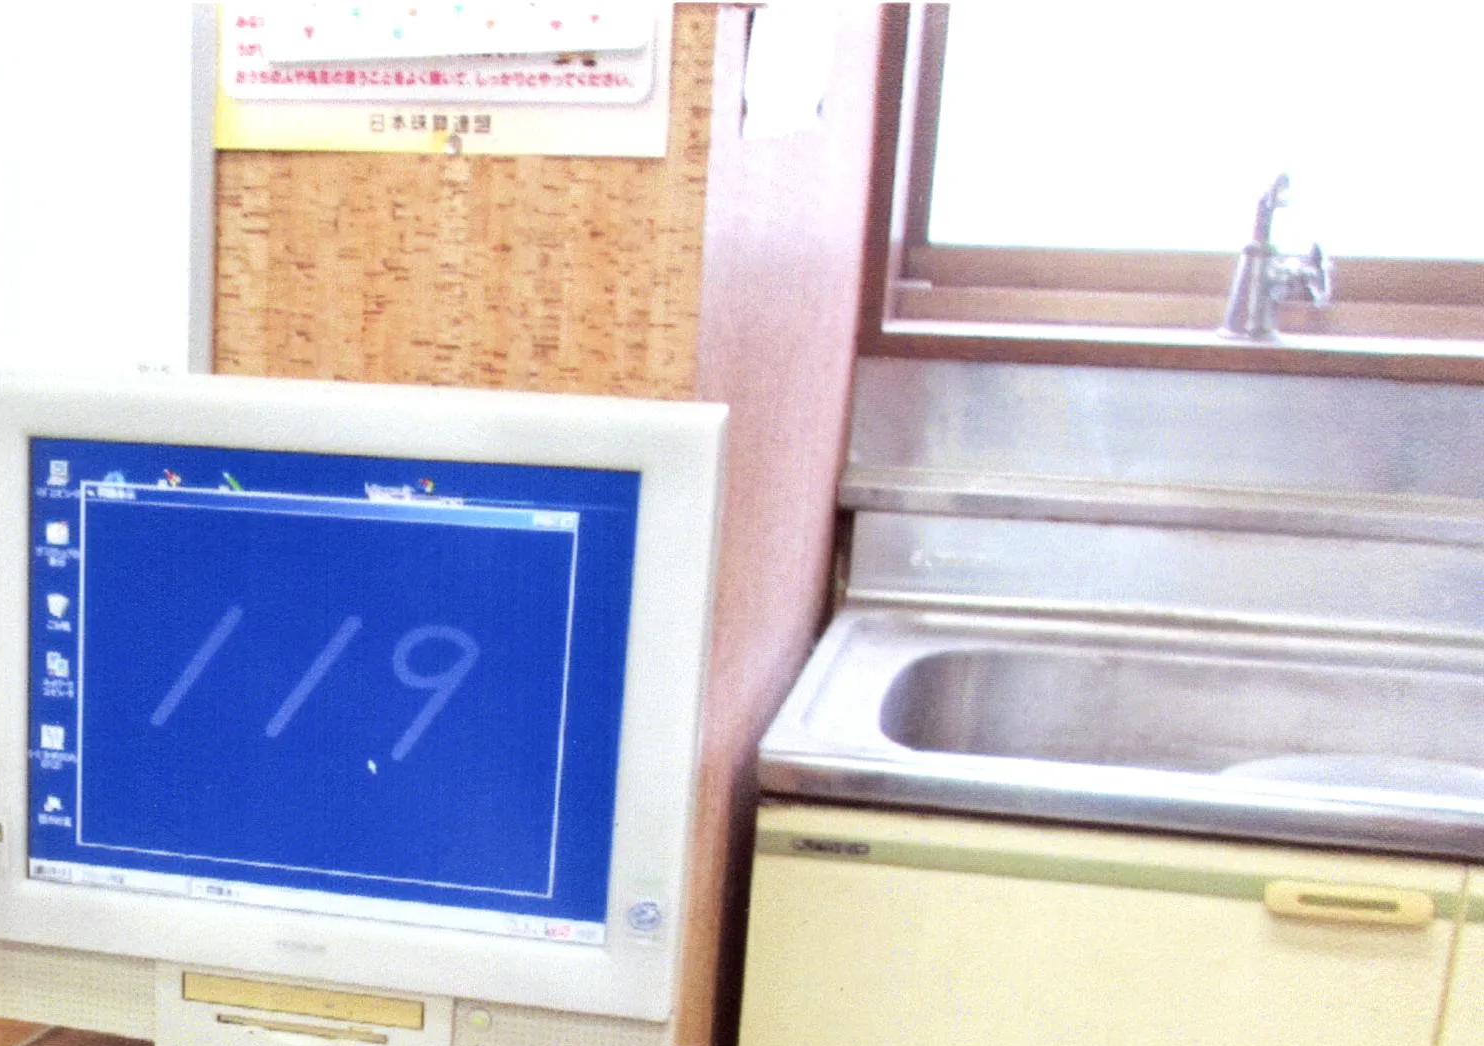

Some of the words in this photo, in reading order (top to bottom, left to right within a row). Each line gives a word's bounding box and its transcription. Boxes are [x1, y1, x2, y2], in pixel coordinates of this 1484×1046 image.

[370, 115, 492, 134] 日本珠算連盟
[150, 606, 479, 763] 119
